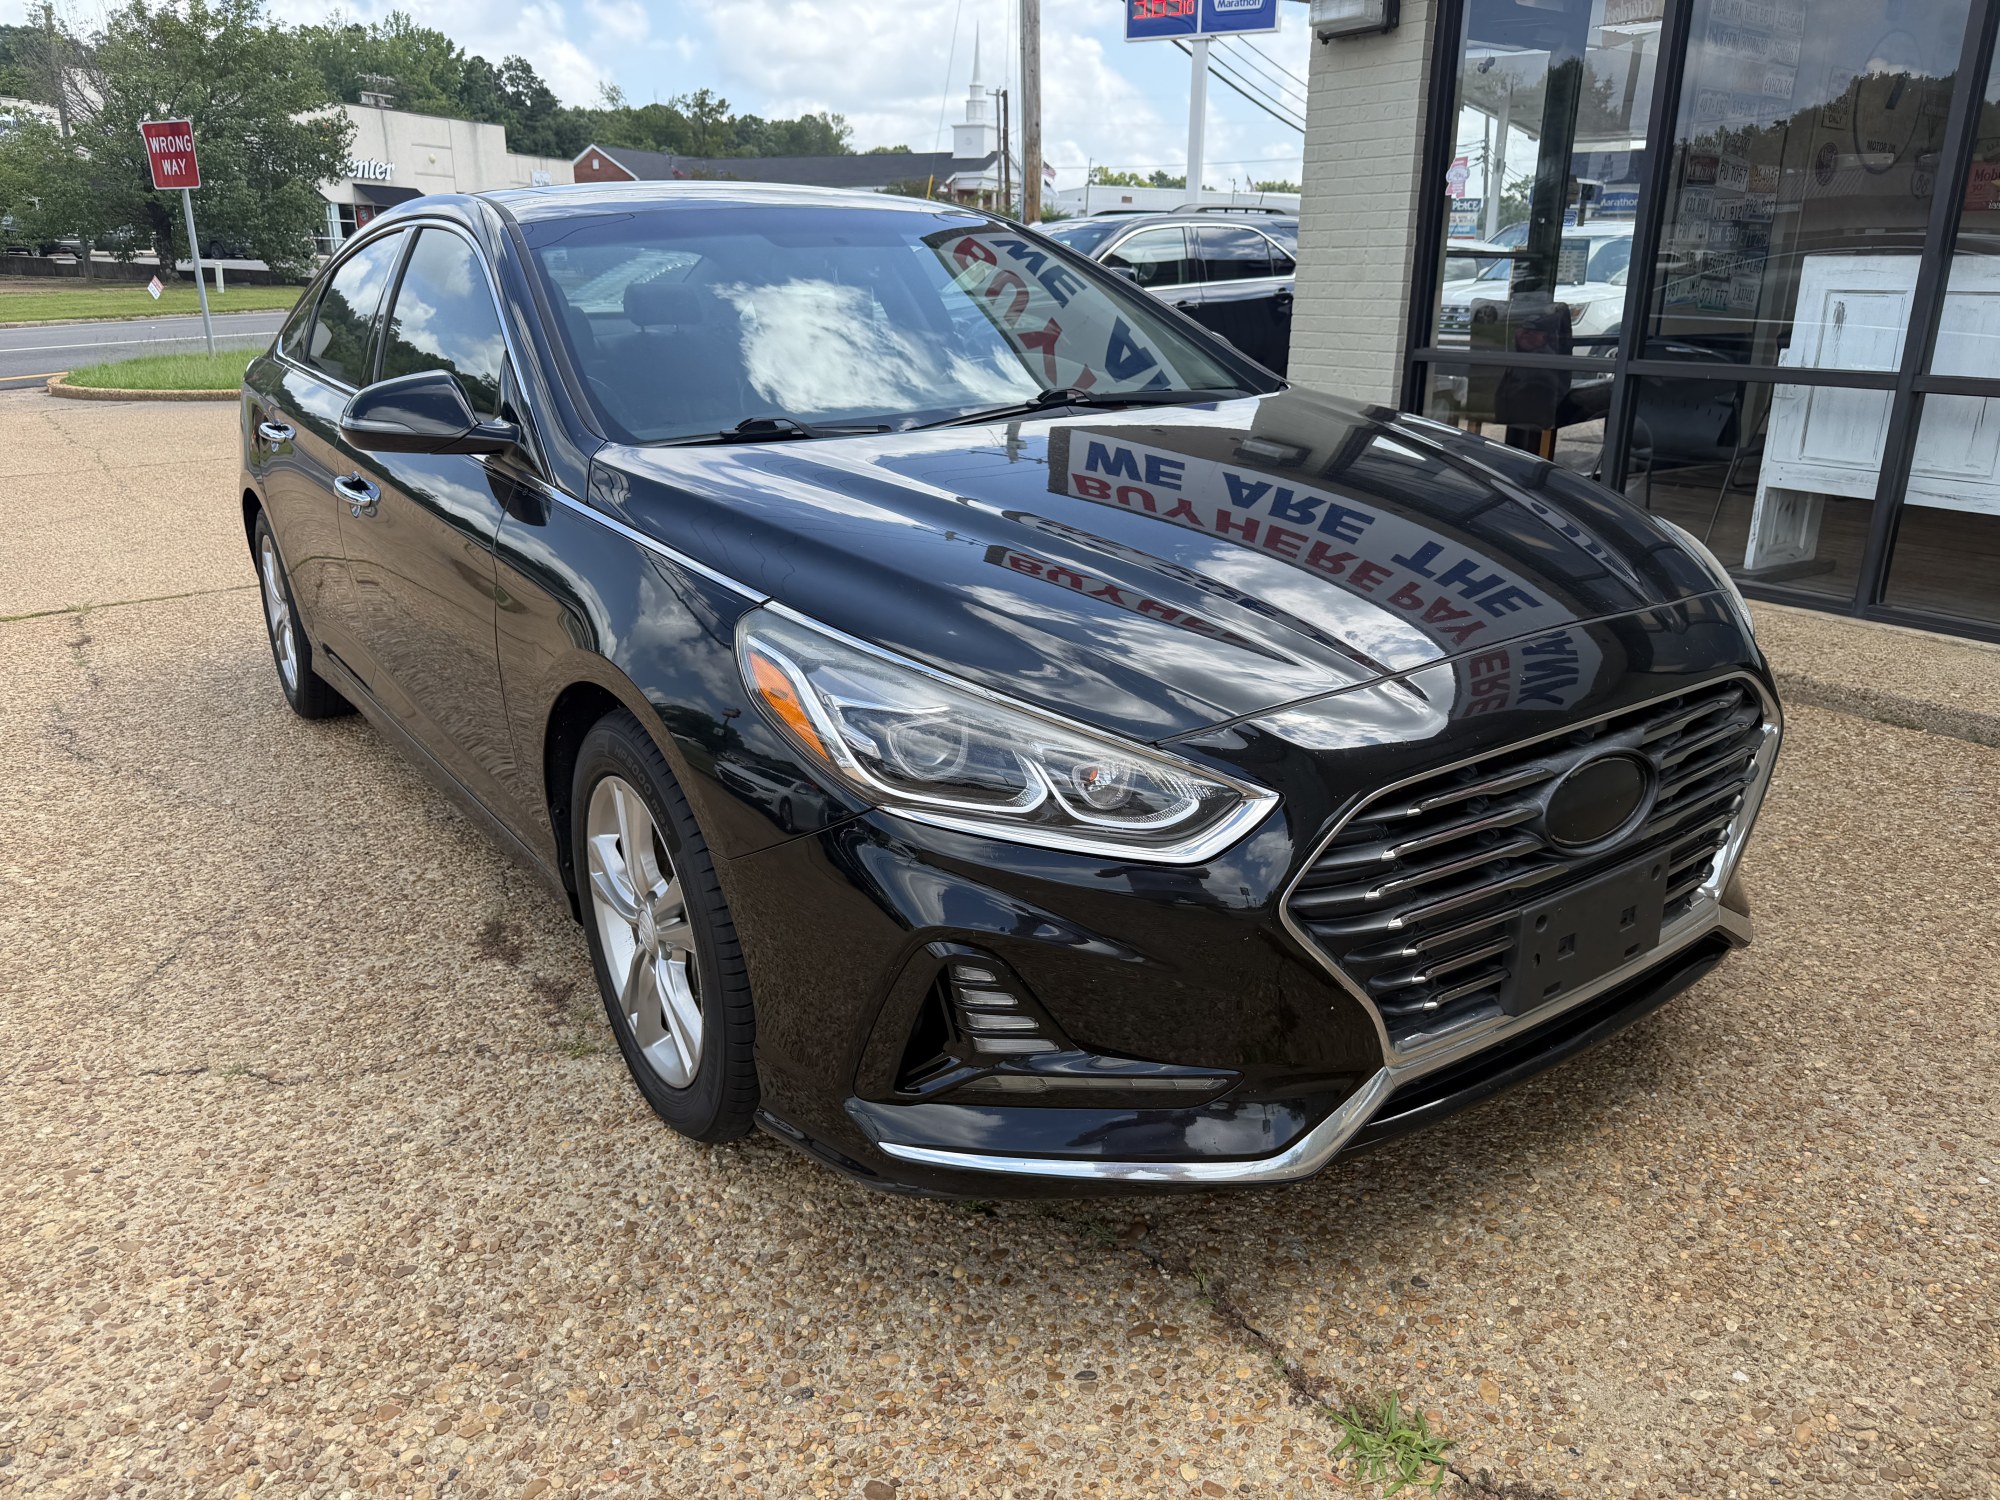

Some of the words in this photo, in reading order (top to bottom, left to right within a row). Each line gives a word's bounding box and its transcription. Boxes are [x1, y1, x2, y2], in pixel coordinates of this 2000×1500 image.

[1217, 0, 1260, 9] Marathon
[149, 135, 191, 153] WRONG
[162, 158, 185, 175] WAY
[337, 157, 396, 180] enter
[1975, 168, 2000, 181] Mob
